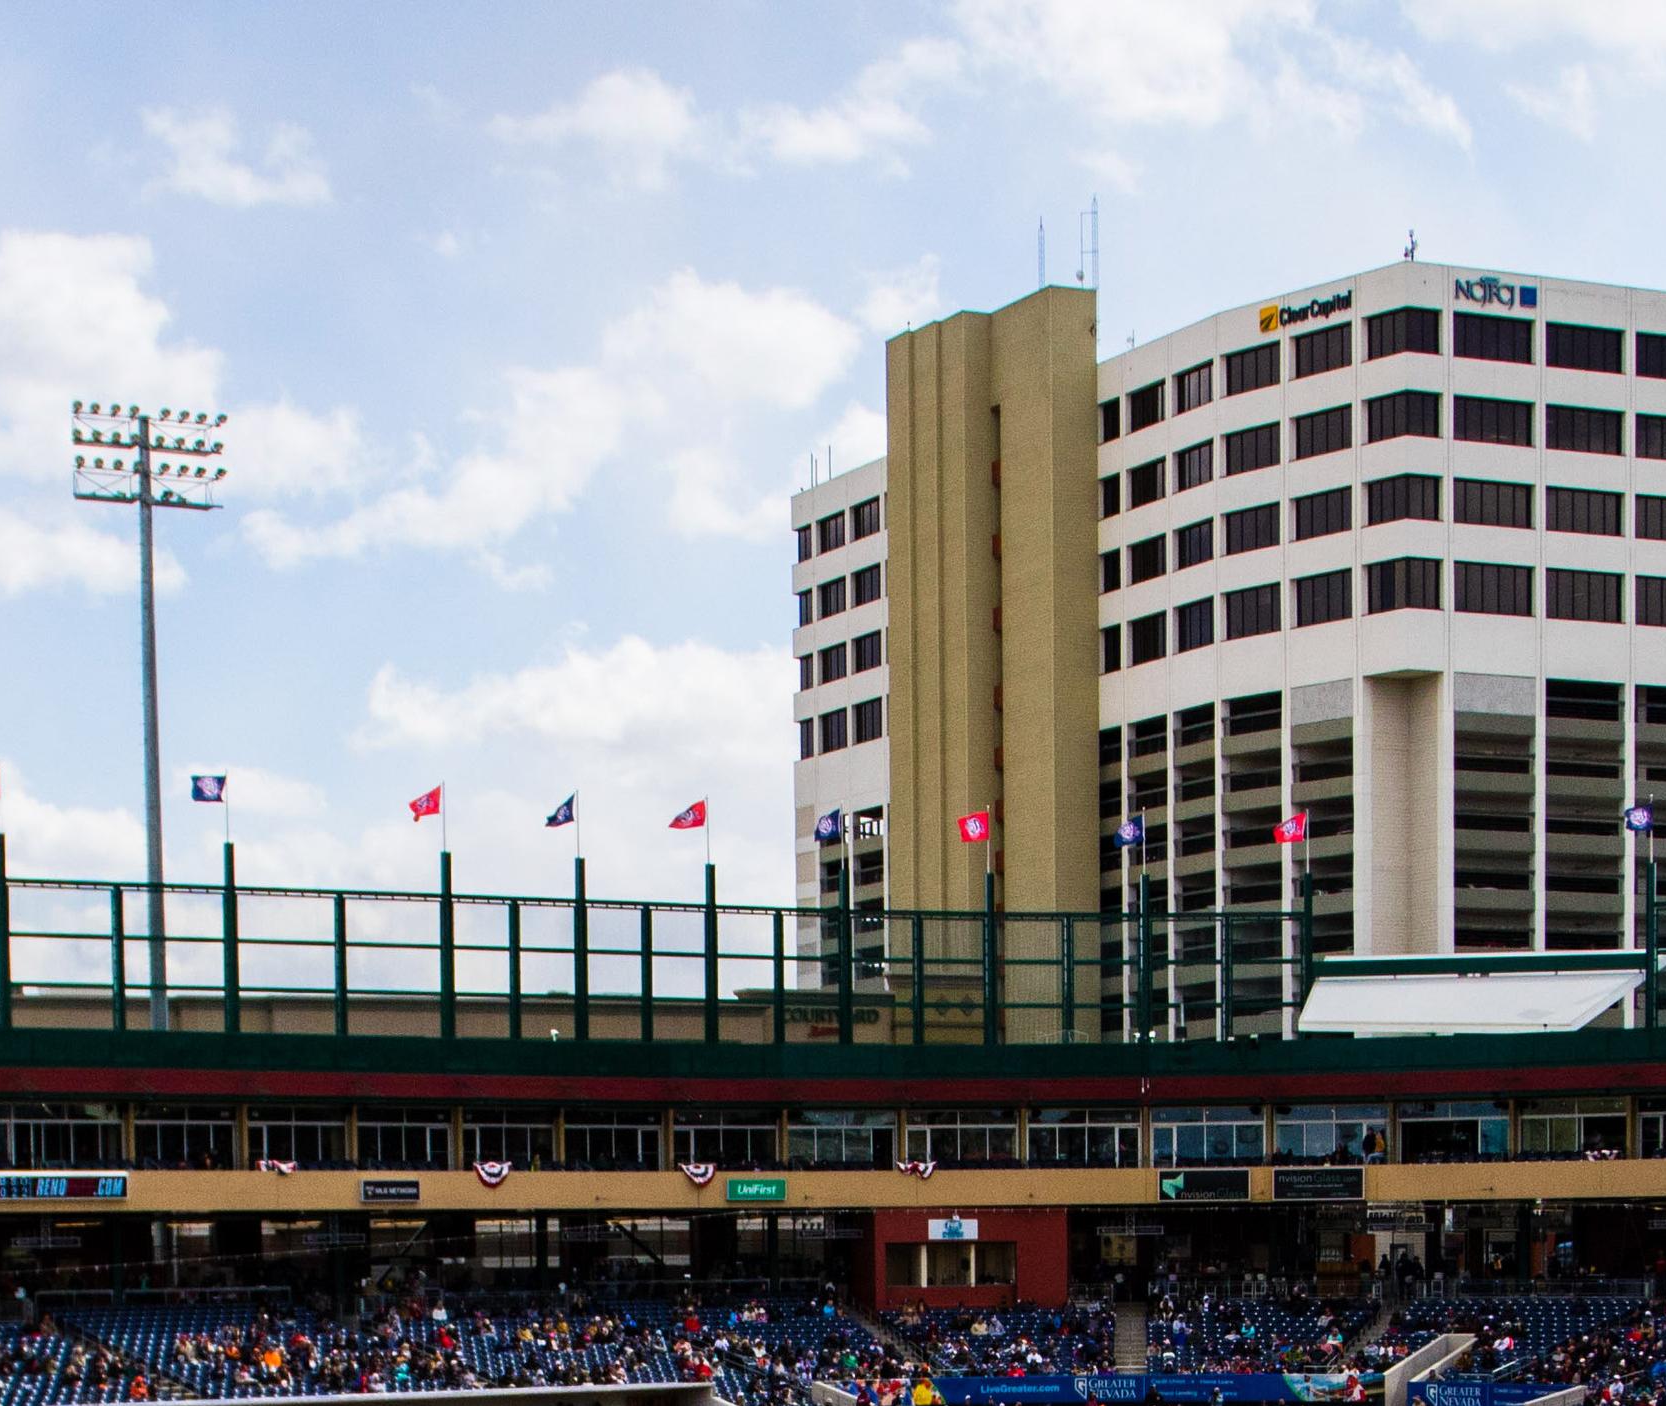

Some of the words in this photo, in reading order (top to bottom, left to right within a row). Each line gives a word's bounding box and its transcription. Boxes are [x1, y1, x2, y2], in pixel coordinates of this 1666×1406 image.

[36, 1178, 68, 1196] RENO
[737, 1183, 776, 1195] UniFirst
[980, 1384, 1060, 1394] LiveGreater.com
[1089, 1378, 1136, 1389] GREATER
[1438, 1385, 1482, 1396] GREATER
